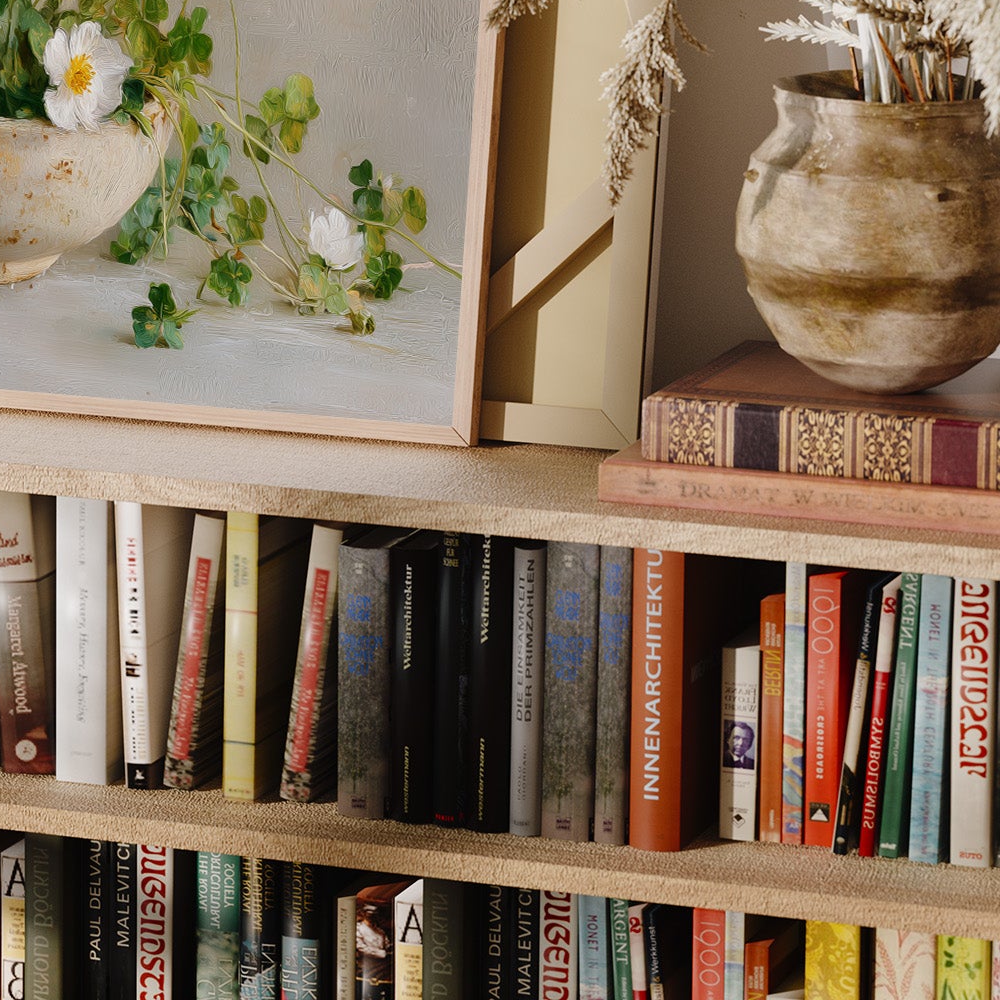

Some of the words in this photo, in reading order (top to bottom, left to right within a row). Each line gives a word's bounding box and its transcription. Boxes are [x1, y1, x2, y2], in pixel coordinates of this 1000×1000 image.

[403, 564, 413, 670] Weltarchitektur
[480, 535, 491, 644] Weltarchitek
[525, 559, 535, 679] PRIMZAHLEN
[6, 594, 23, 656] Margaret
[517, 574, 525, 685] EINSAMKEIT
[11, 661, 32, 714] Atwood
[643, 549, 664, 801] INNENARCHITEKTU
[89, 840, 102, 918] DELVAU
[89, 923, 101, 961] PAUL
[488, 885, 502, 957] DELVAU
[587, 915, 598, 951] MONET
[613, 899, 628, 965] ARGENT
[648, 926, 660, 974] Werkkunst
[694, 921, 720, 986] 1900
